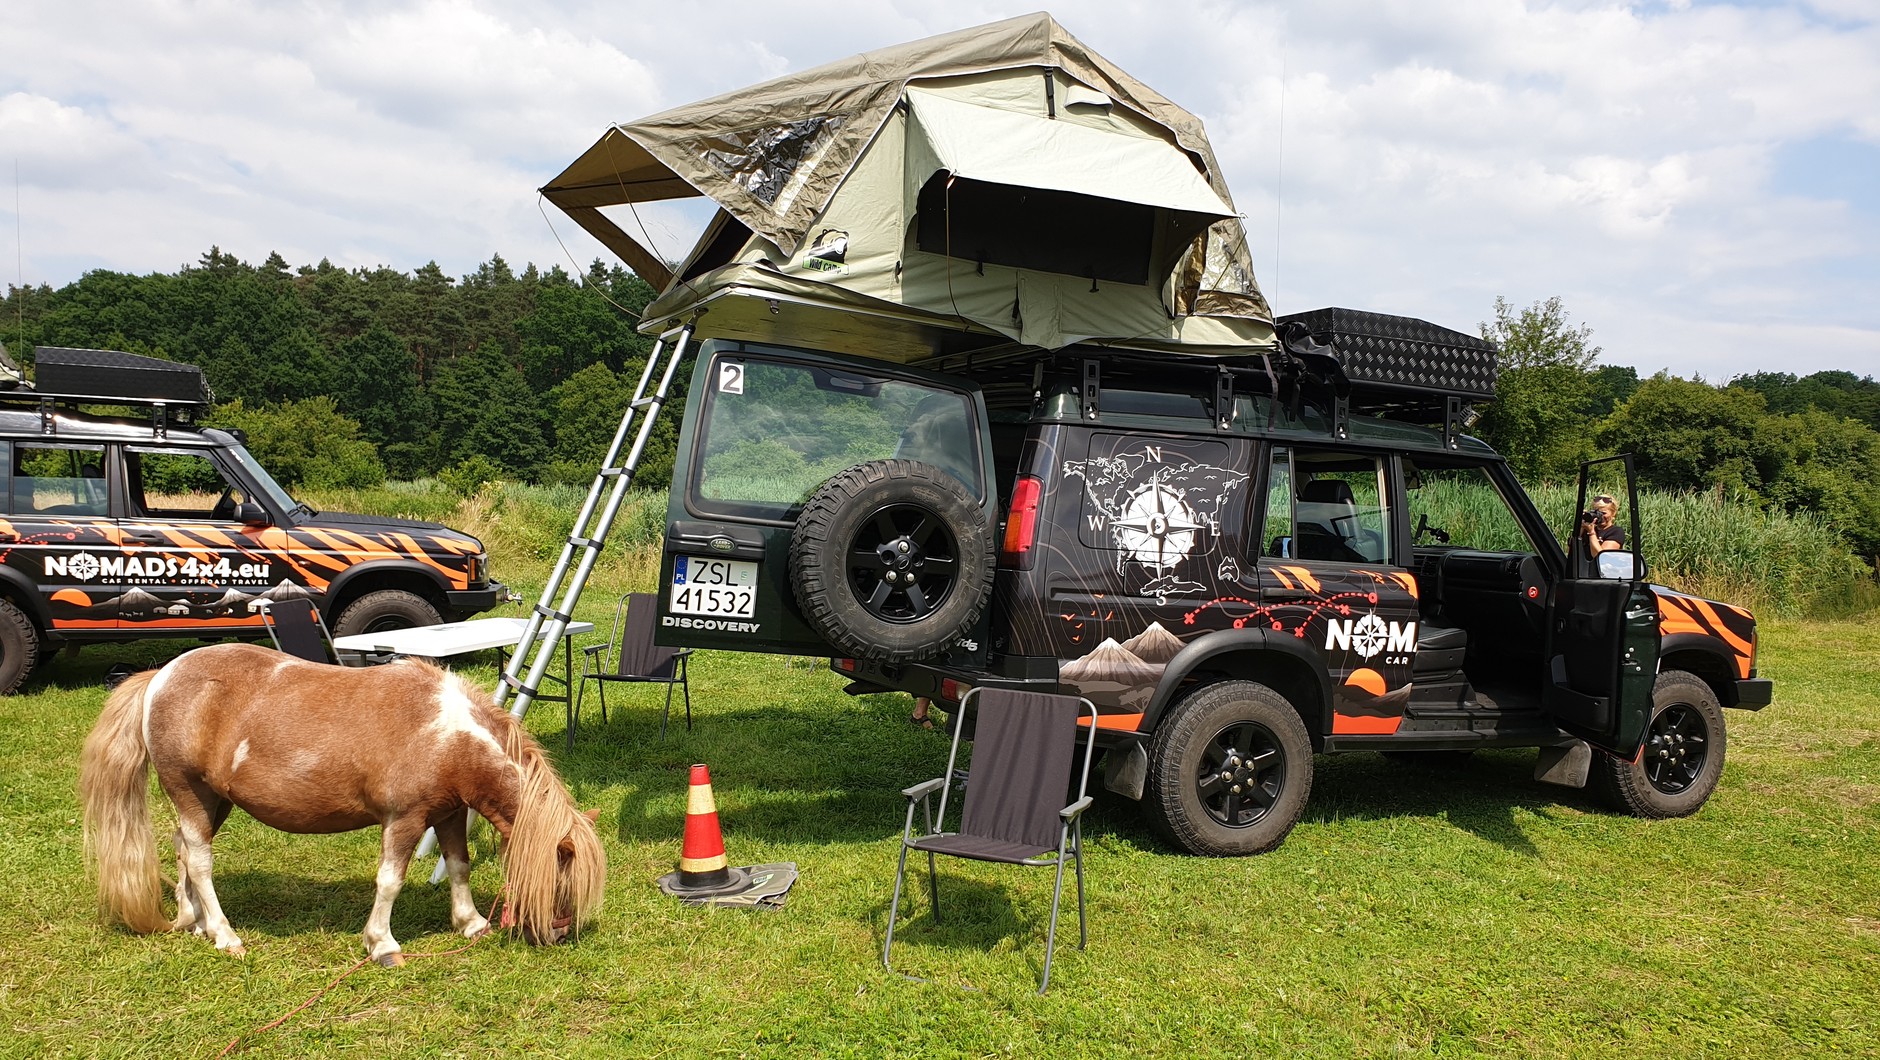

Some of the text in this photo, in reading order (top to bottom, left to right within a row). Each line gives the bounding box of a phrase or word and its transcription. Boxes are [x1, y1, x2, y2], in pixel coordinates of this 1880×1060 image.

[723, 365, 741, 392] 2
[1144, 445, 1162, 463] N
[1087, 514, 1105, 532] W
[1210, 521, 1221, 537] E
[692, 560, 738, 586] ZSL
[676, 588, 751, 614] 41532
[662, 616, 760, 633] DISCOVERY
[1325, 611, 1418, 660] NOM
[1385, 656, 1409, 665] CAR
